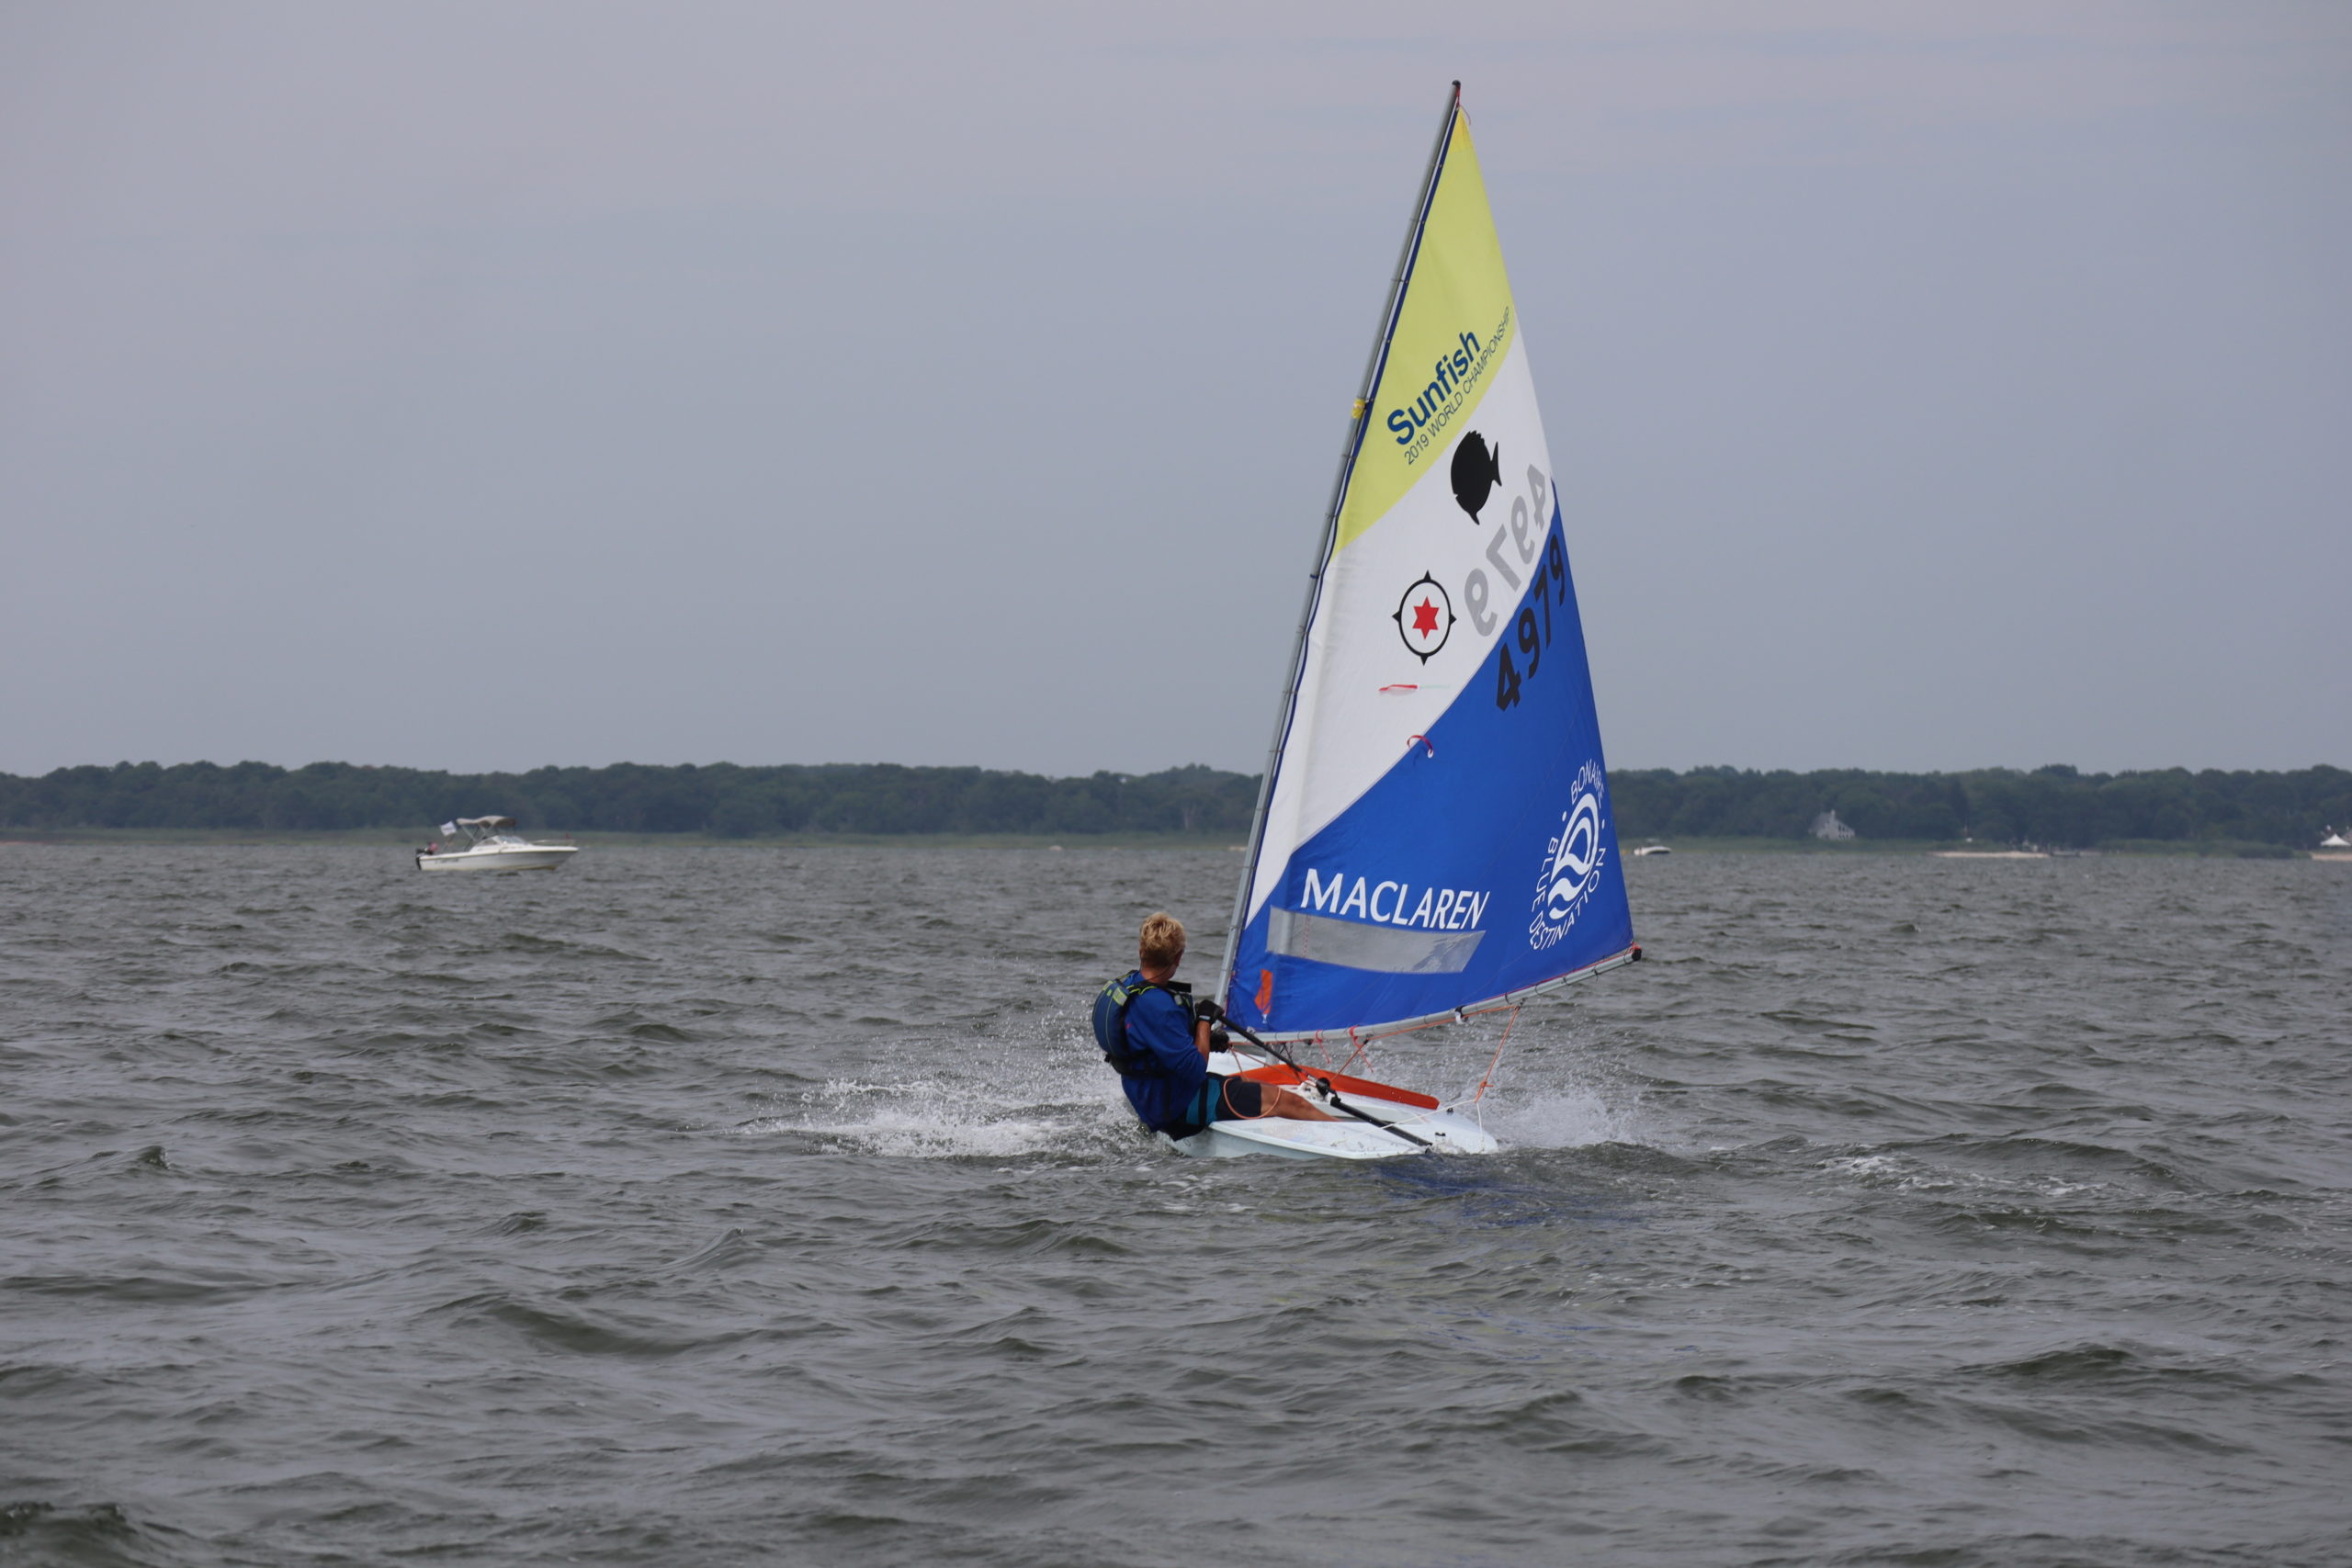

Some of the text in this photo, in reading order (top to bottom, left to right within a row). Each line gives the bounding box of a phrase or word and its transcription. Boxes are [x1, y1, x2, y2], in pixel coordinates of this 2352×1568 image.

[1386, 331, 1481, 446] Sunfish
[1404, 306, 1510, 465] 2019 WORLD CHAMPIONSHIP
[1496, 534, 1566, 711] 4979
[1570, 758, 1605, 809] BONAIRE
[1300, 868, 1490, 930] MACLAREN
[1529, 837, 1606, 950] BLUE DESTINATION
